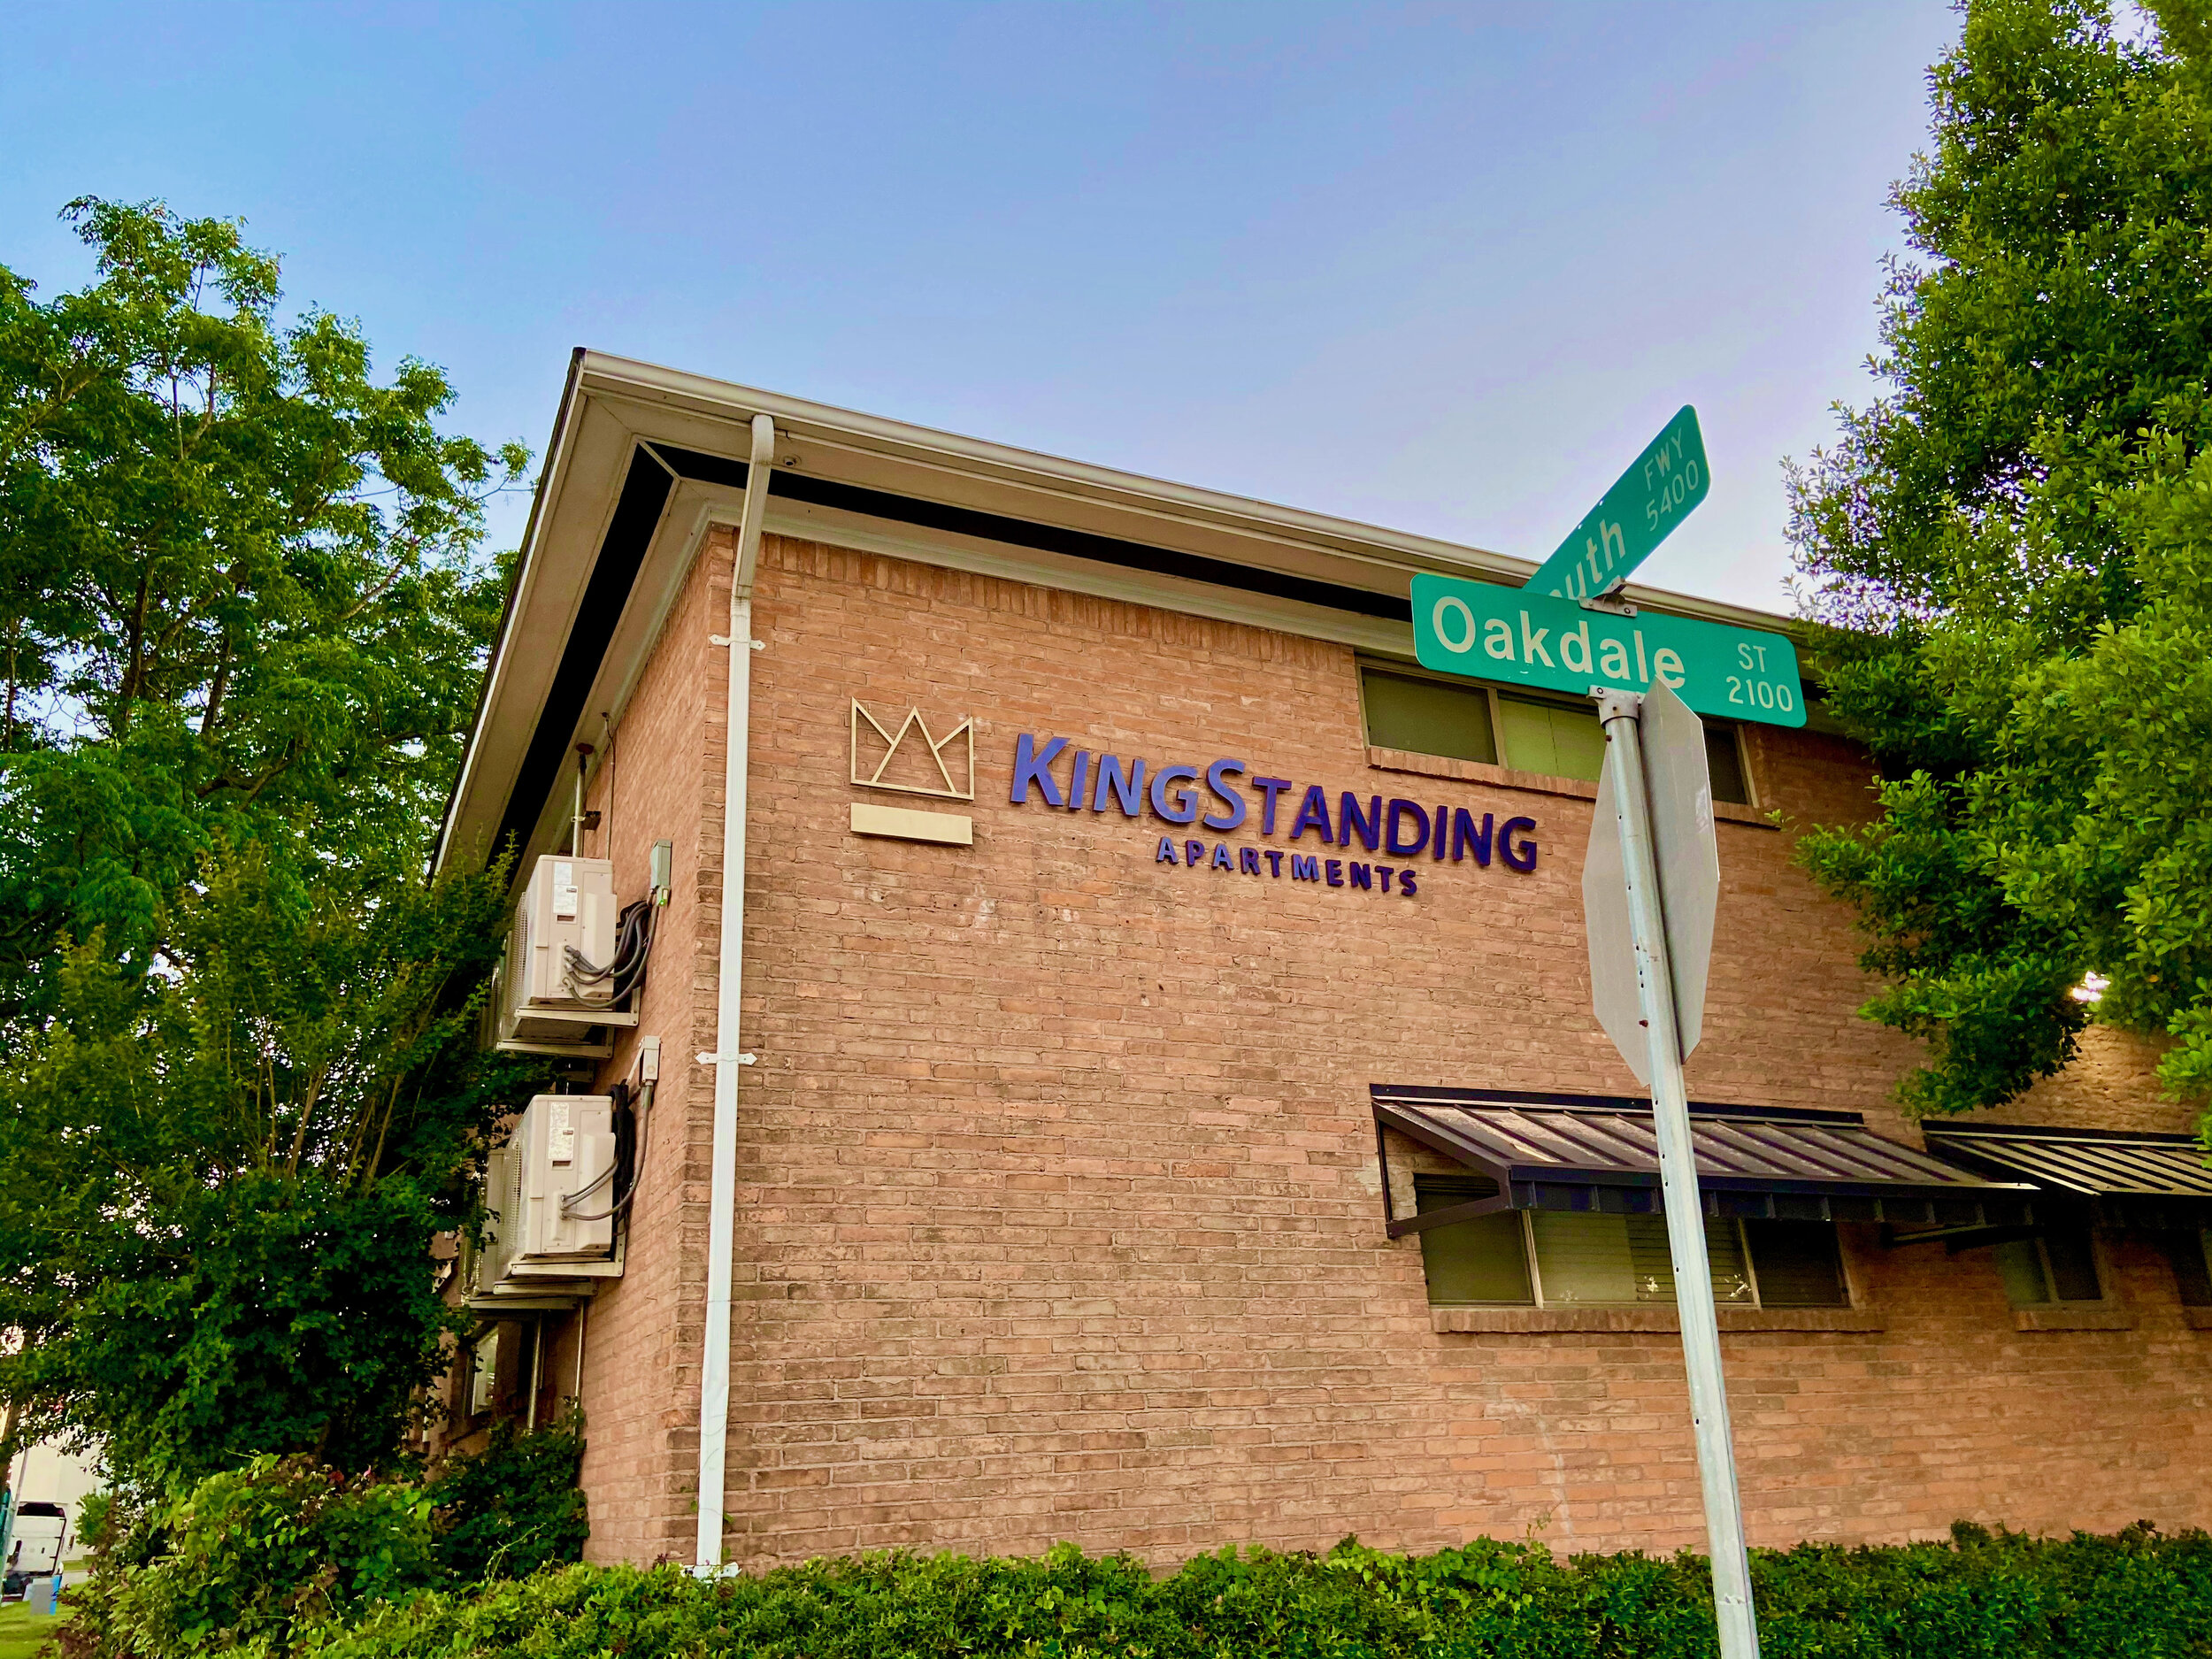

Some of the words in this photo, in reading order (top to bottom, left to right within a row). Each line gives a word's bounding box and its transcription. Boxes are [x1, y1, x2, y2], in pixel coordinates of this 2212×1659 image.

[1548, 518, 1626, 601] uth
[1644, 426, 1683, 491] FWY
[1646, 459, 1699, 532] 5400
[1432, 595, 1686, 689] Oakdale
[1737, 642, 1767, 672] ST
[1725, 675, 1793, 712] 2100
[1010, 732, 1538, 872] KINGSTANDING
[1156, 836, 1417, 896] APARTMENTS
